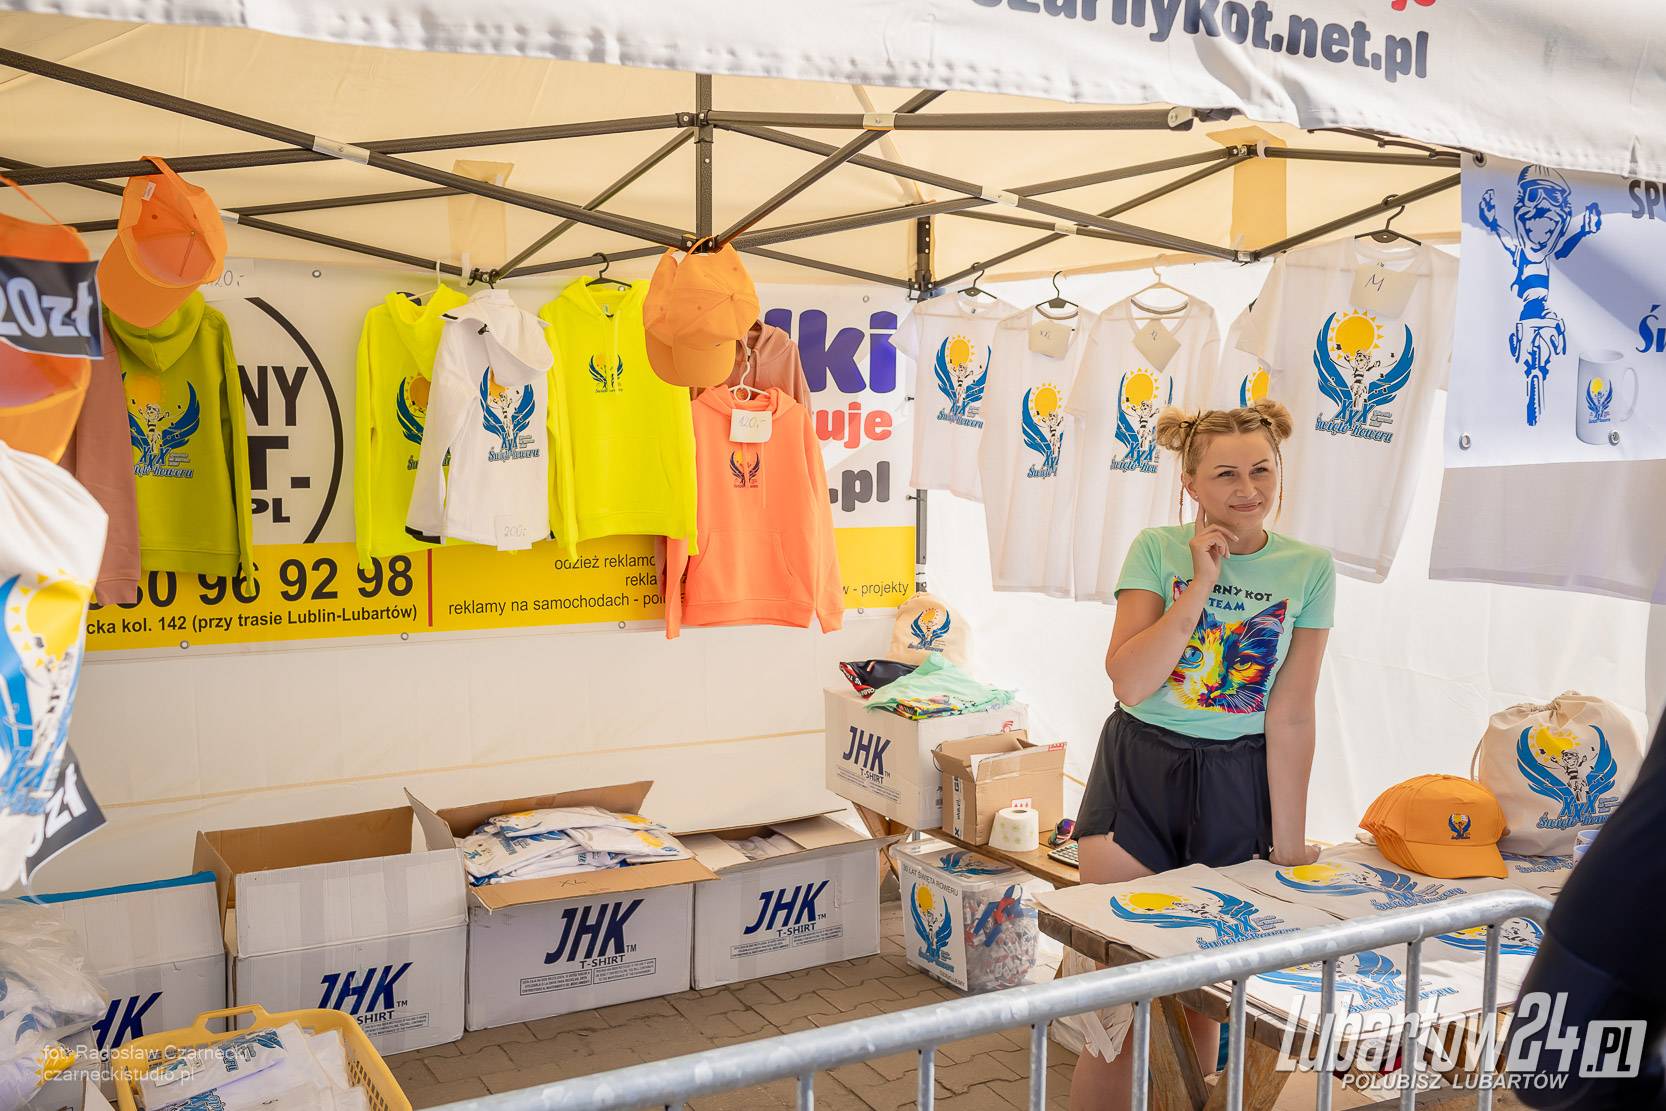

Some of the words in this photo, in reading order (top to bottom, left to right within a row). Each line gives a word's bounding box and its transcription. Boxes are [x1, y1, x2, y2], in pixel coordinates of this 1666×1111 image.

[1365, 273, 1384, 292] M
[237, 365, 309, 427] NY
[815, 401, 893, 449] uje
[247, 435, 311, 490] T-
[829, 461, 890, 512] .pl
[251, 497, 290, 523] PL
[604, 554, 656, 568] reklamo
[279, 557, 338, 602] 92
[356, 554, 414, 599] 98
[625, 572, 657, 586] rekla
[449, 599, 507, 616] reklamy
[511, 599, 529, 612] na
[533, 592, 630, 611] samochodach
[861, 580, 909, 598] projekty
[1208, 597, 1246, 611] TEAM
[1245, 589, 1273, 602] KOT
[86, 619, 116, 635] cka
[122, 617, 152, 633] kol.
[158, 615, 187, 631] 142
[192, 614, 233, 633] (przy
[238, 611, 283, 627] trasie
[287, 604, 418, 624] Lublin-Lubartów)
[842, 725, 892, 776] JHK
[860, 767, 884, 785] T-SHIRT
[45, 762, 87, 839] zł
[743, 879, 830, 935] JHK
[543, 898, 645, 965] JHK
[775, 922, 817, 938] T-SHIRT
[580, 954, 626, 970] T-SHIRT
[91, 991, 164, 1052] HK
[356, 1010, 395, 1026] SHIRT
